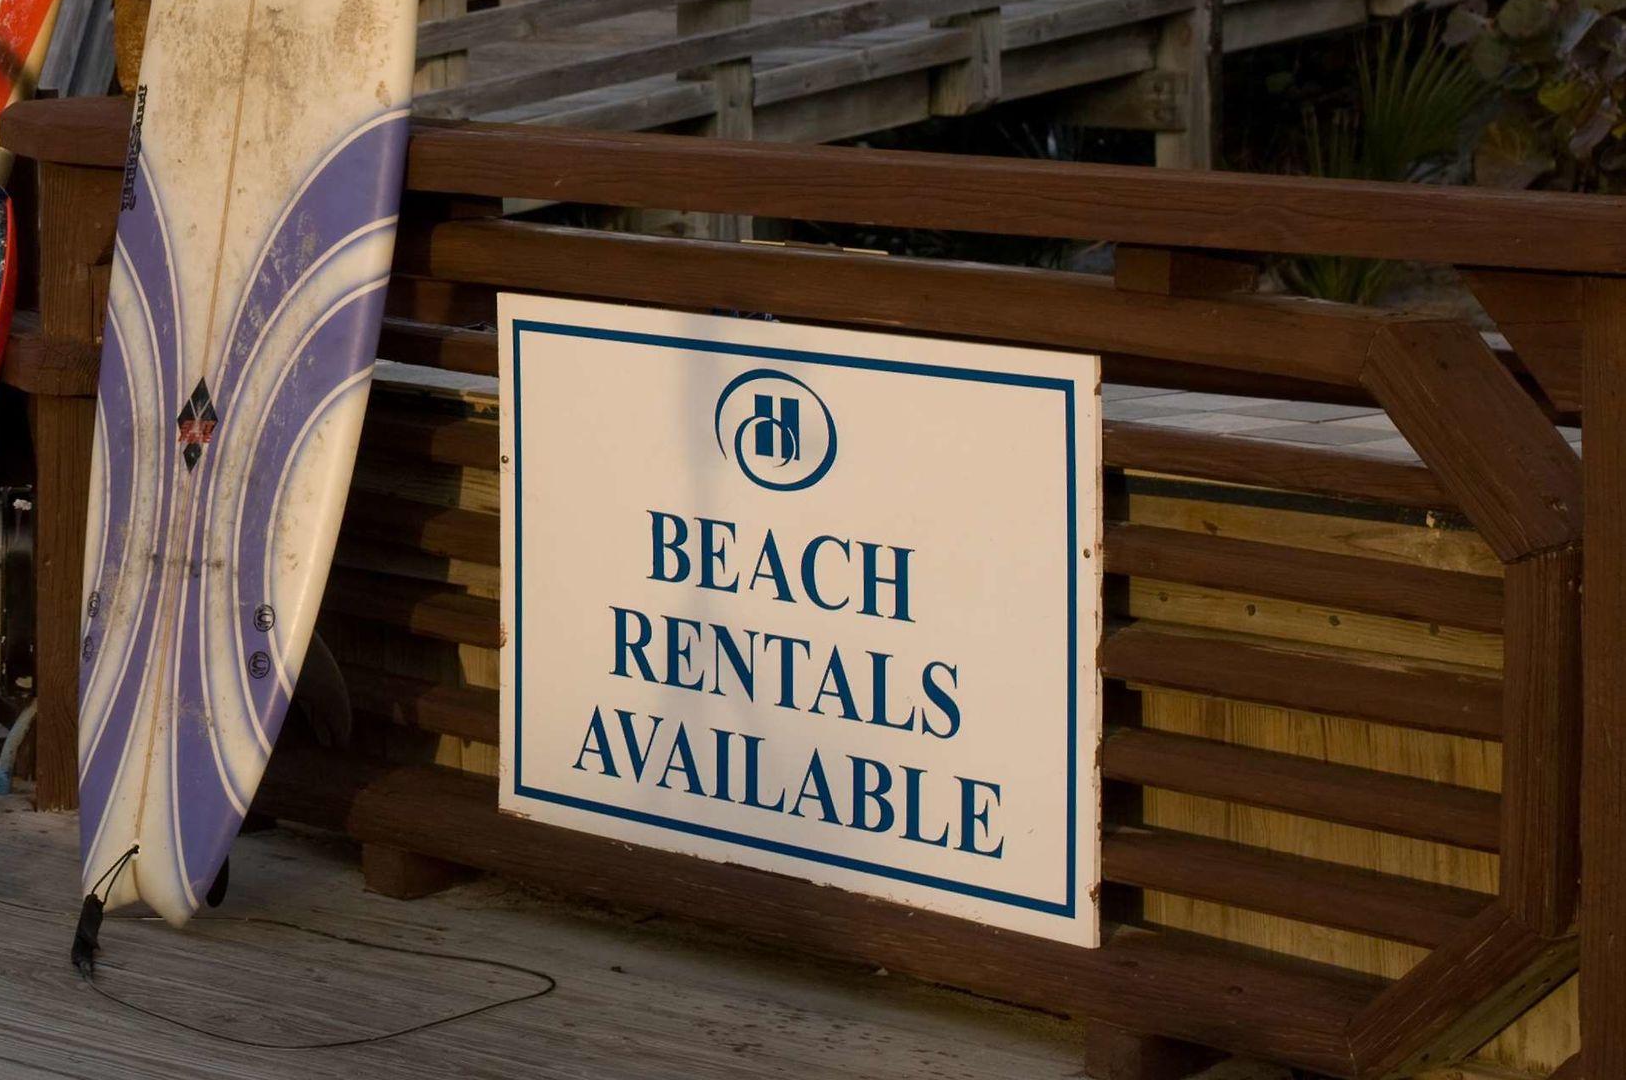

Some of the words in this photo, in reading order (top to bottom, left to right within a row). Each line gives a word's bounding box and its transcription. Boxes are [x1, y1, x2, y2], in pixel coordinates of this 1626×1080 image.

[647, 510, 916, 625] BEACH
[608, 605, 962, 740] RENTALS
[573, 704, 1006, 860] AVAILABLE
